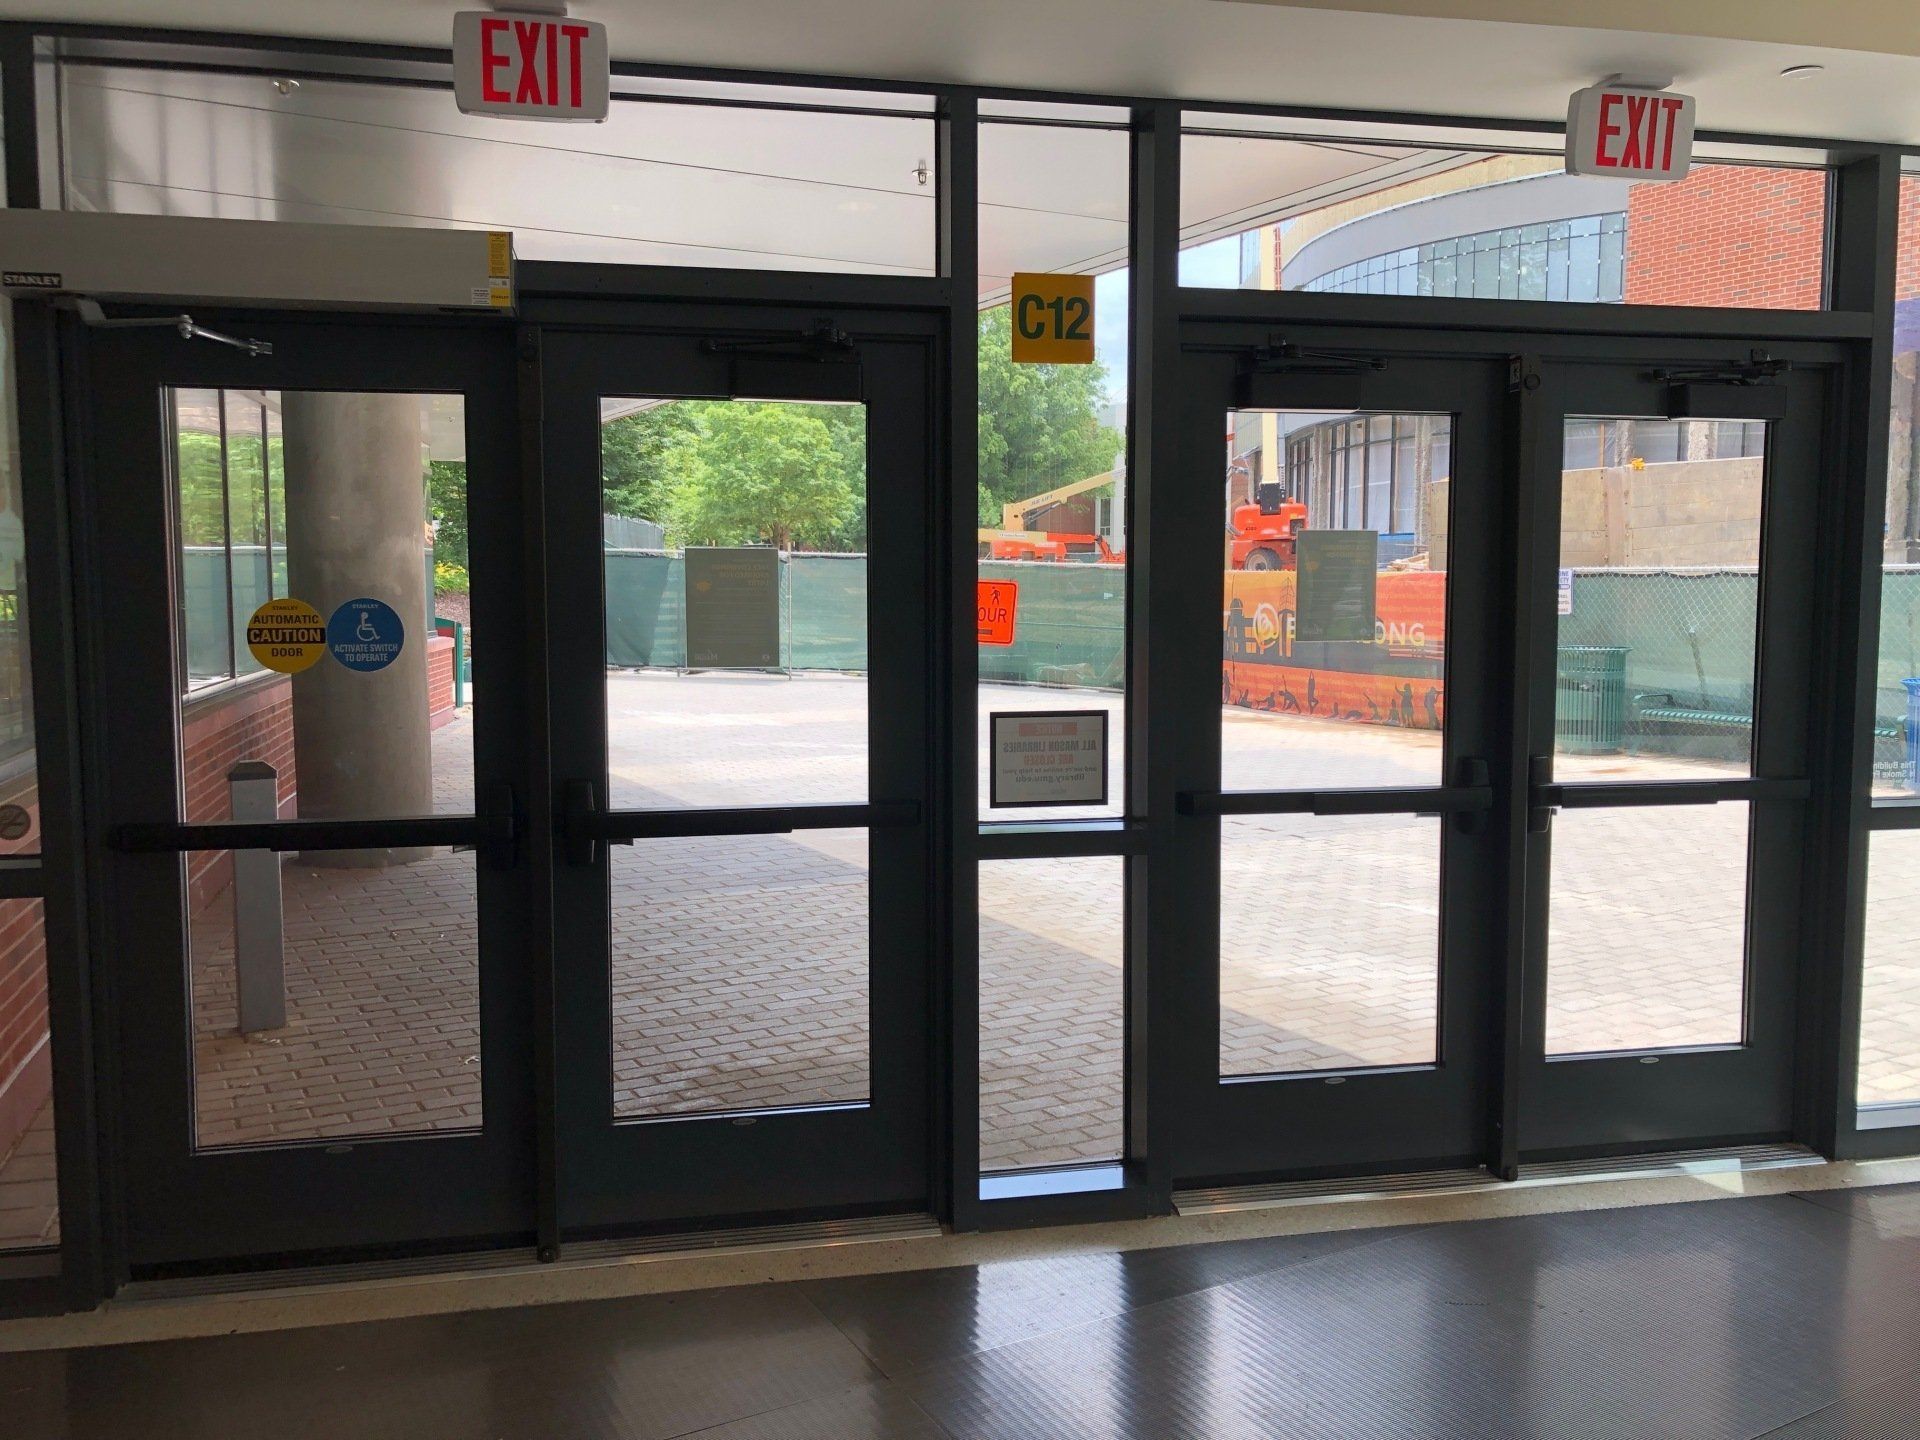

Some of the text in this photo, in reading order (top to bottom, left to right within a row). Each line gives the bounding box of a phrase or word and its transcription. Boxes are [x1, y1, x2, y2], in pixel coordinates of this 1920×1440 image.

[481, 18, 589, 108] EXIT
[1595, 94, 1683, 171] EXIT
[4, 274, 60, 286] STANLEY
[1018, 294, 1091, 341] C12
[253, 614, 319, 625] AUTOMATIC
[978, 607, 1007, 623] OUR
[250, 629, 321, 643] CAUTION
[1374, 619, 1425, 647] ONG
[271, 647, 303, 657] DOOR
[334, 643, 399, 653] ACTIVATE SWITCH
[345, 653, 388, 662] TO OPERATE
